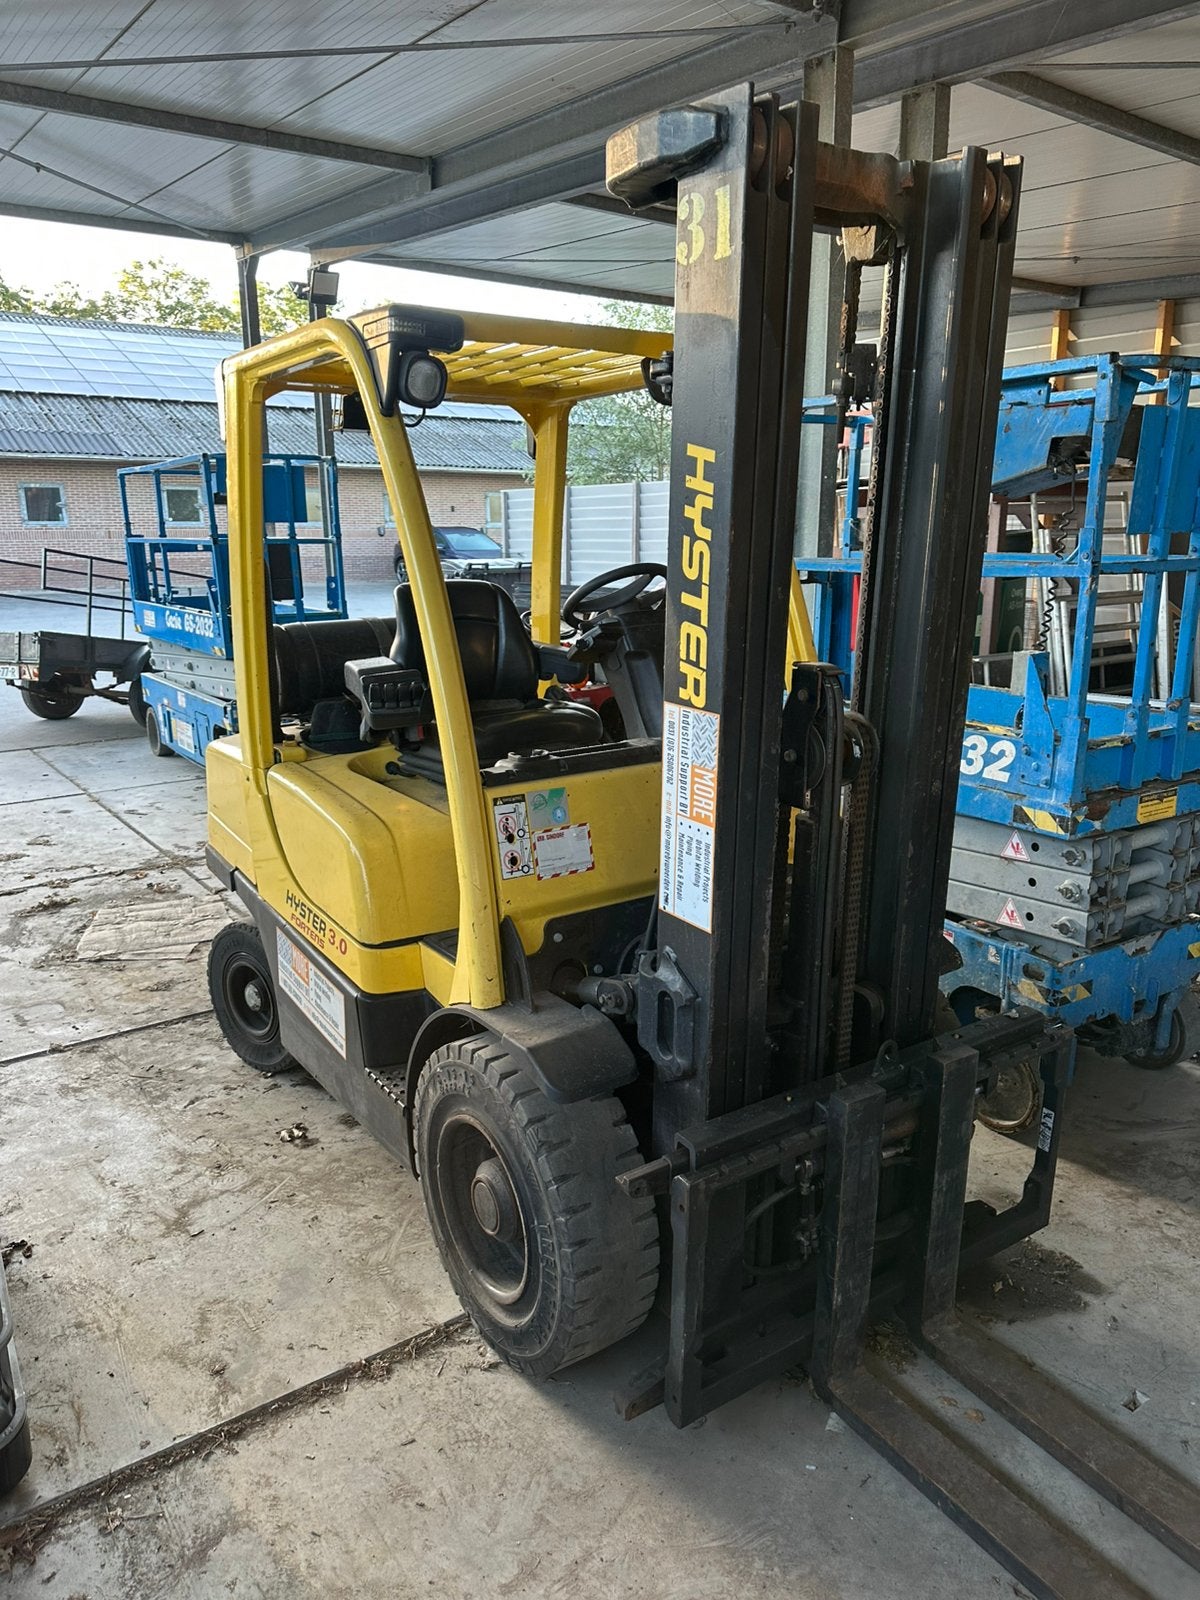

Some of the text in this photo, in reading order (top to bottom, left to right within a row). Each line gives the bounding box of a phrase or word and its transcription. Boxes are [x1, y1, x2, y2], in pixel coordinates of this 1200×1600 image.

[676, 184, 733, 266] 31
[679, 443, 716, 709] HYSTER
[679, 709, 691, 815] Industrial Support BV
[960, 734, 1016, 783] 32
[693, 768, 715, 823] MORE
[677, 832, 685, 873] Maintenance
[685, 835, 694, 856] Piping
[693, 839, 703, 888] Orbital Welding
[676, 880, 684, 901] Repair
[702, 842, 711, 903] Industrial Projects
[286, 889, 347, 955] HYSTER 3.0
[291, 913, 325, 949] FORTENS
